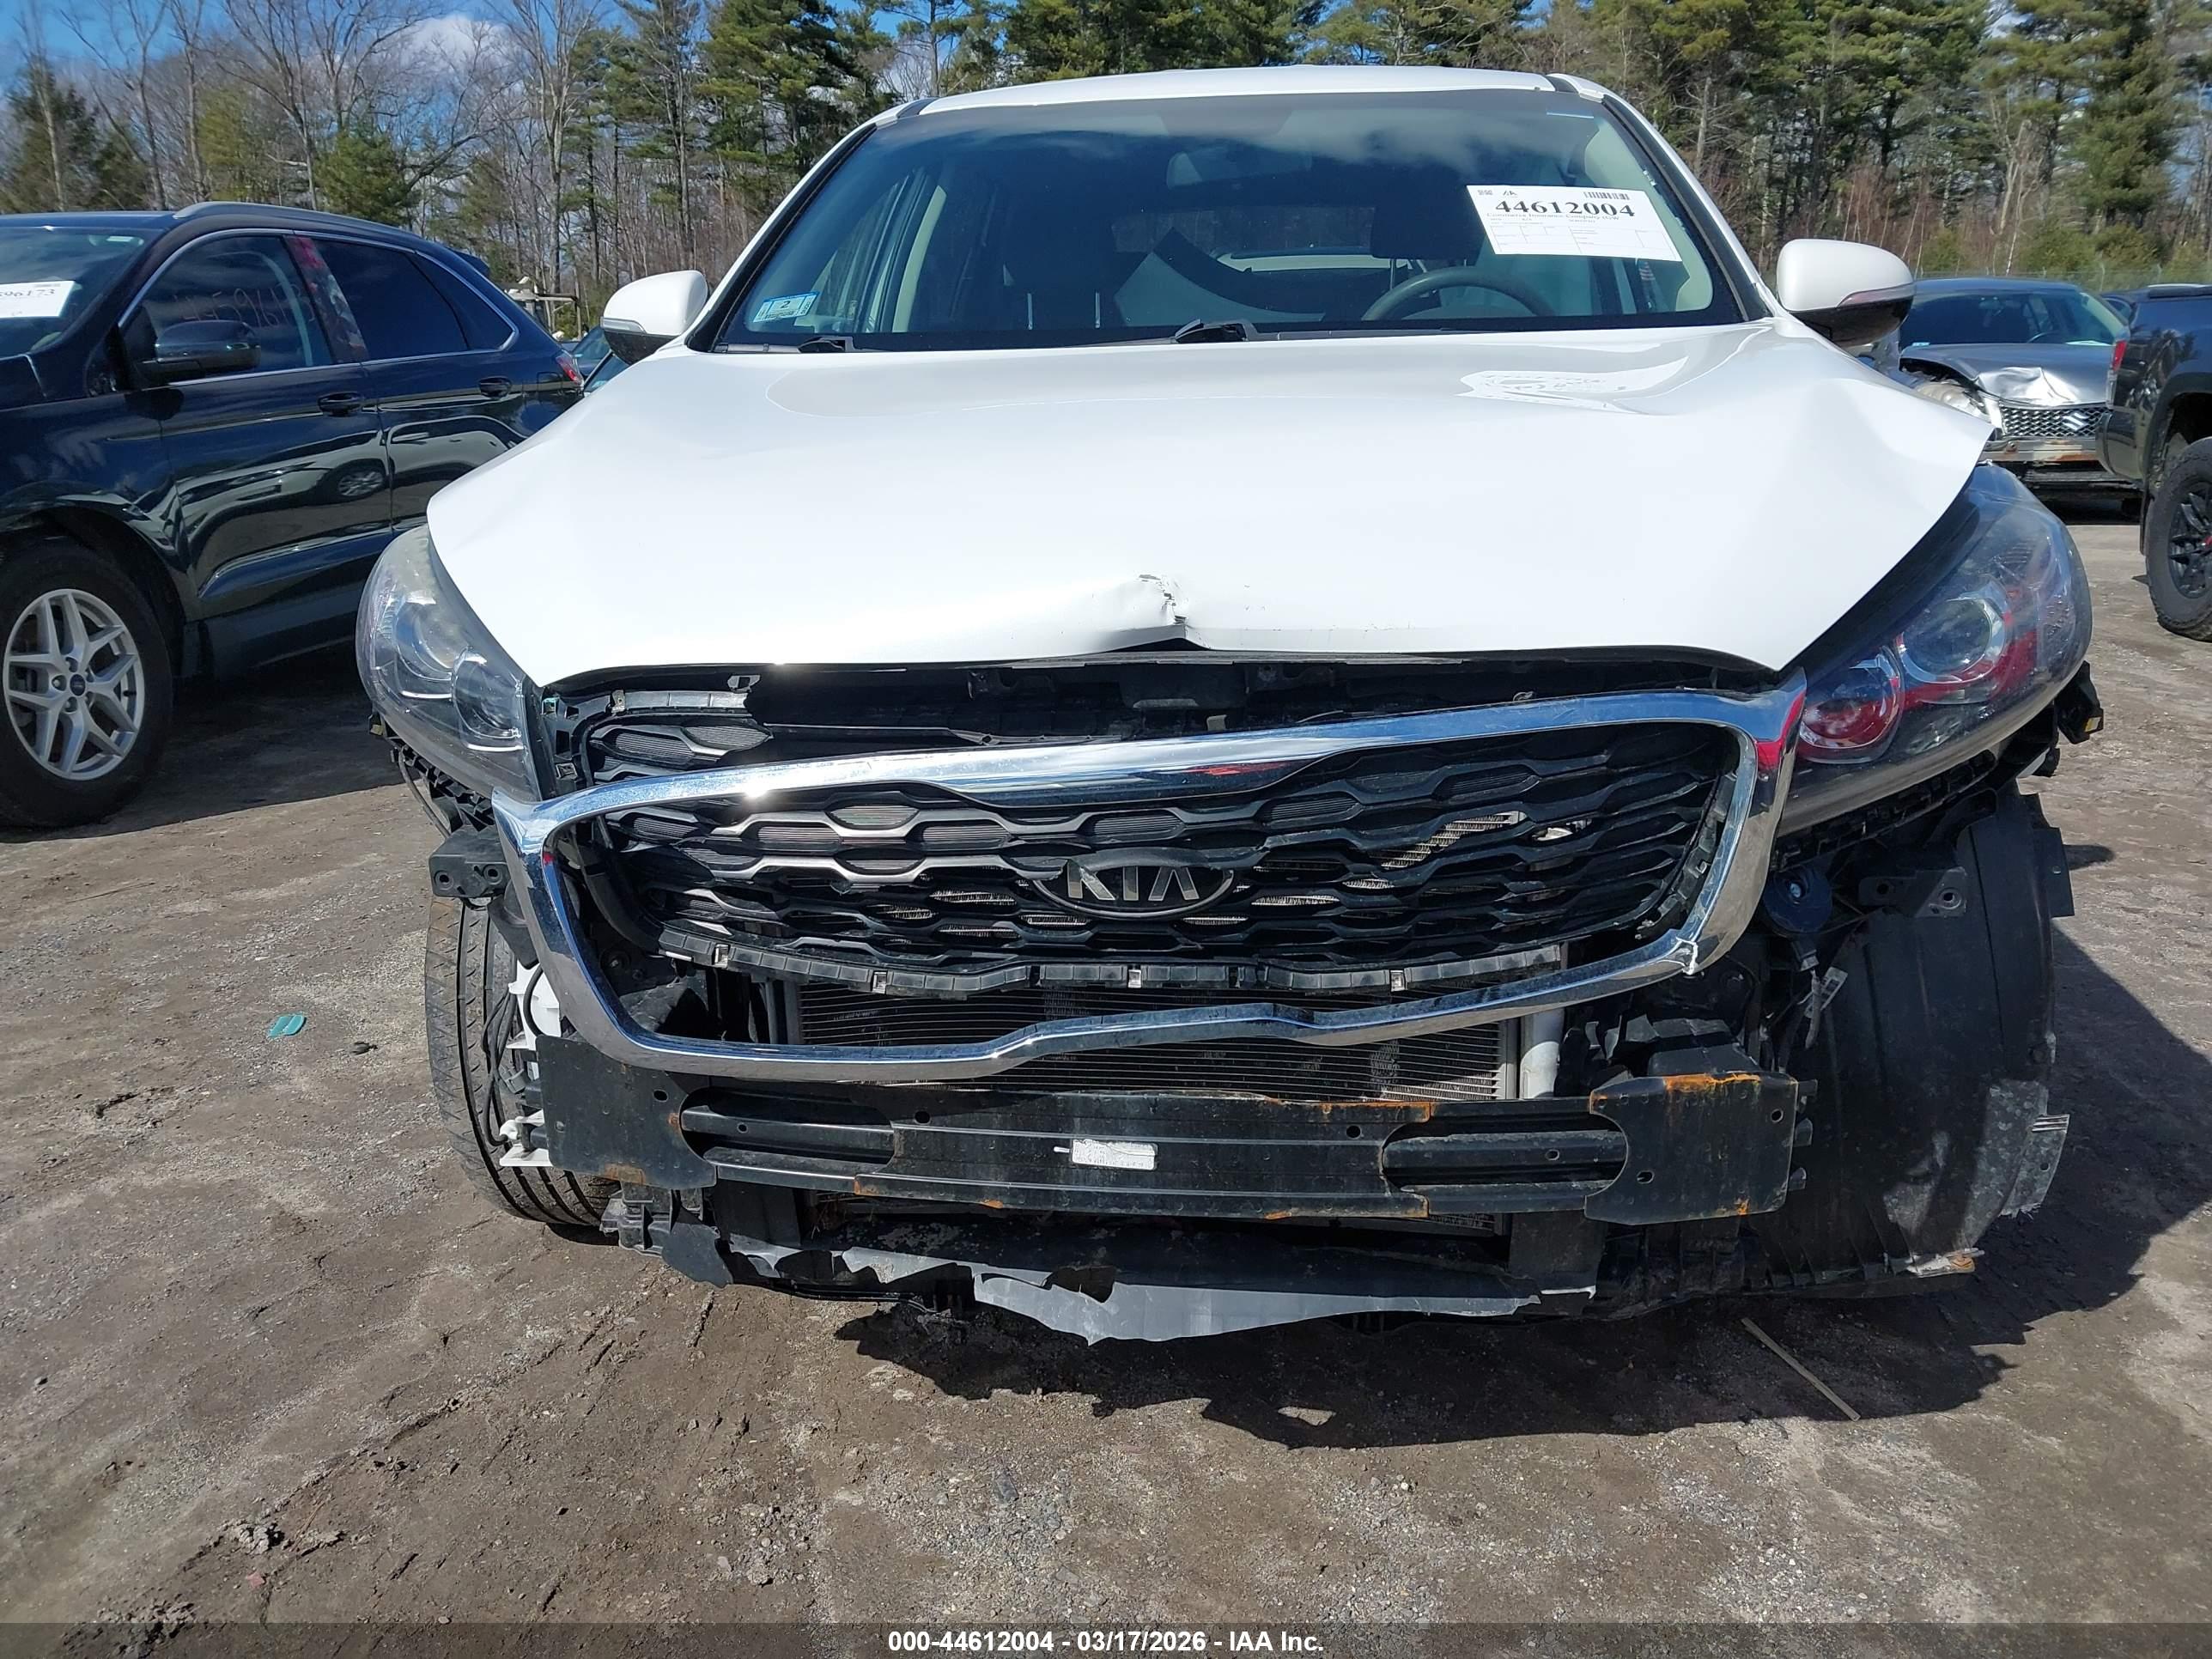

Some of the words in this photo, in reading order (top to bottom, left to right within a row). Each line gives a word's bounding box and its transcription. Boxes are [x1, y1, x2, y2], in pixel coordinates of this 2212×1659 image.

[1495, 200, 1635, 216] 44612004
[780, 301, 791, 309] 2
[1066, 864, 1200, 901] KIA
